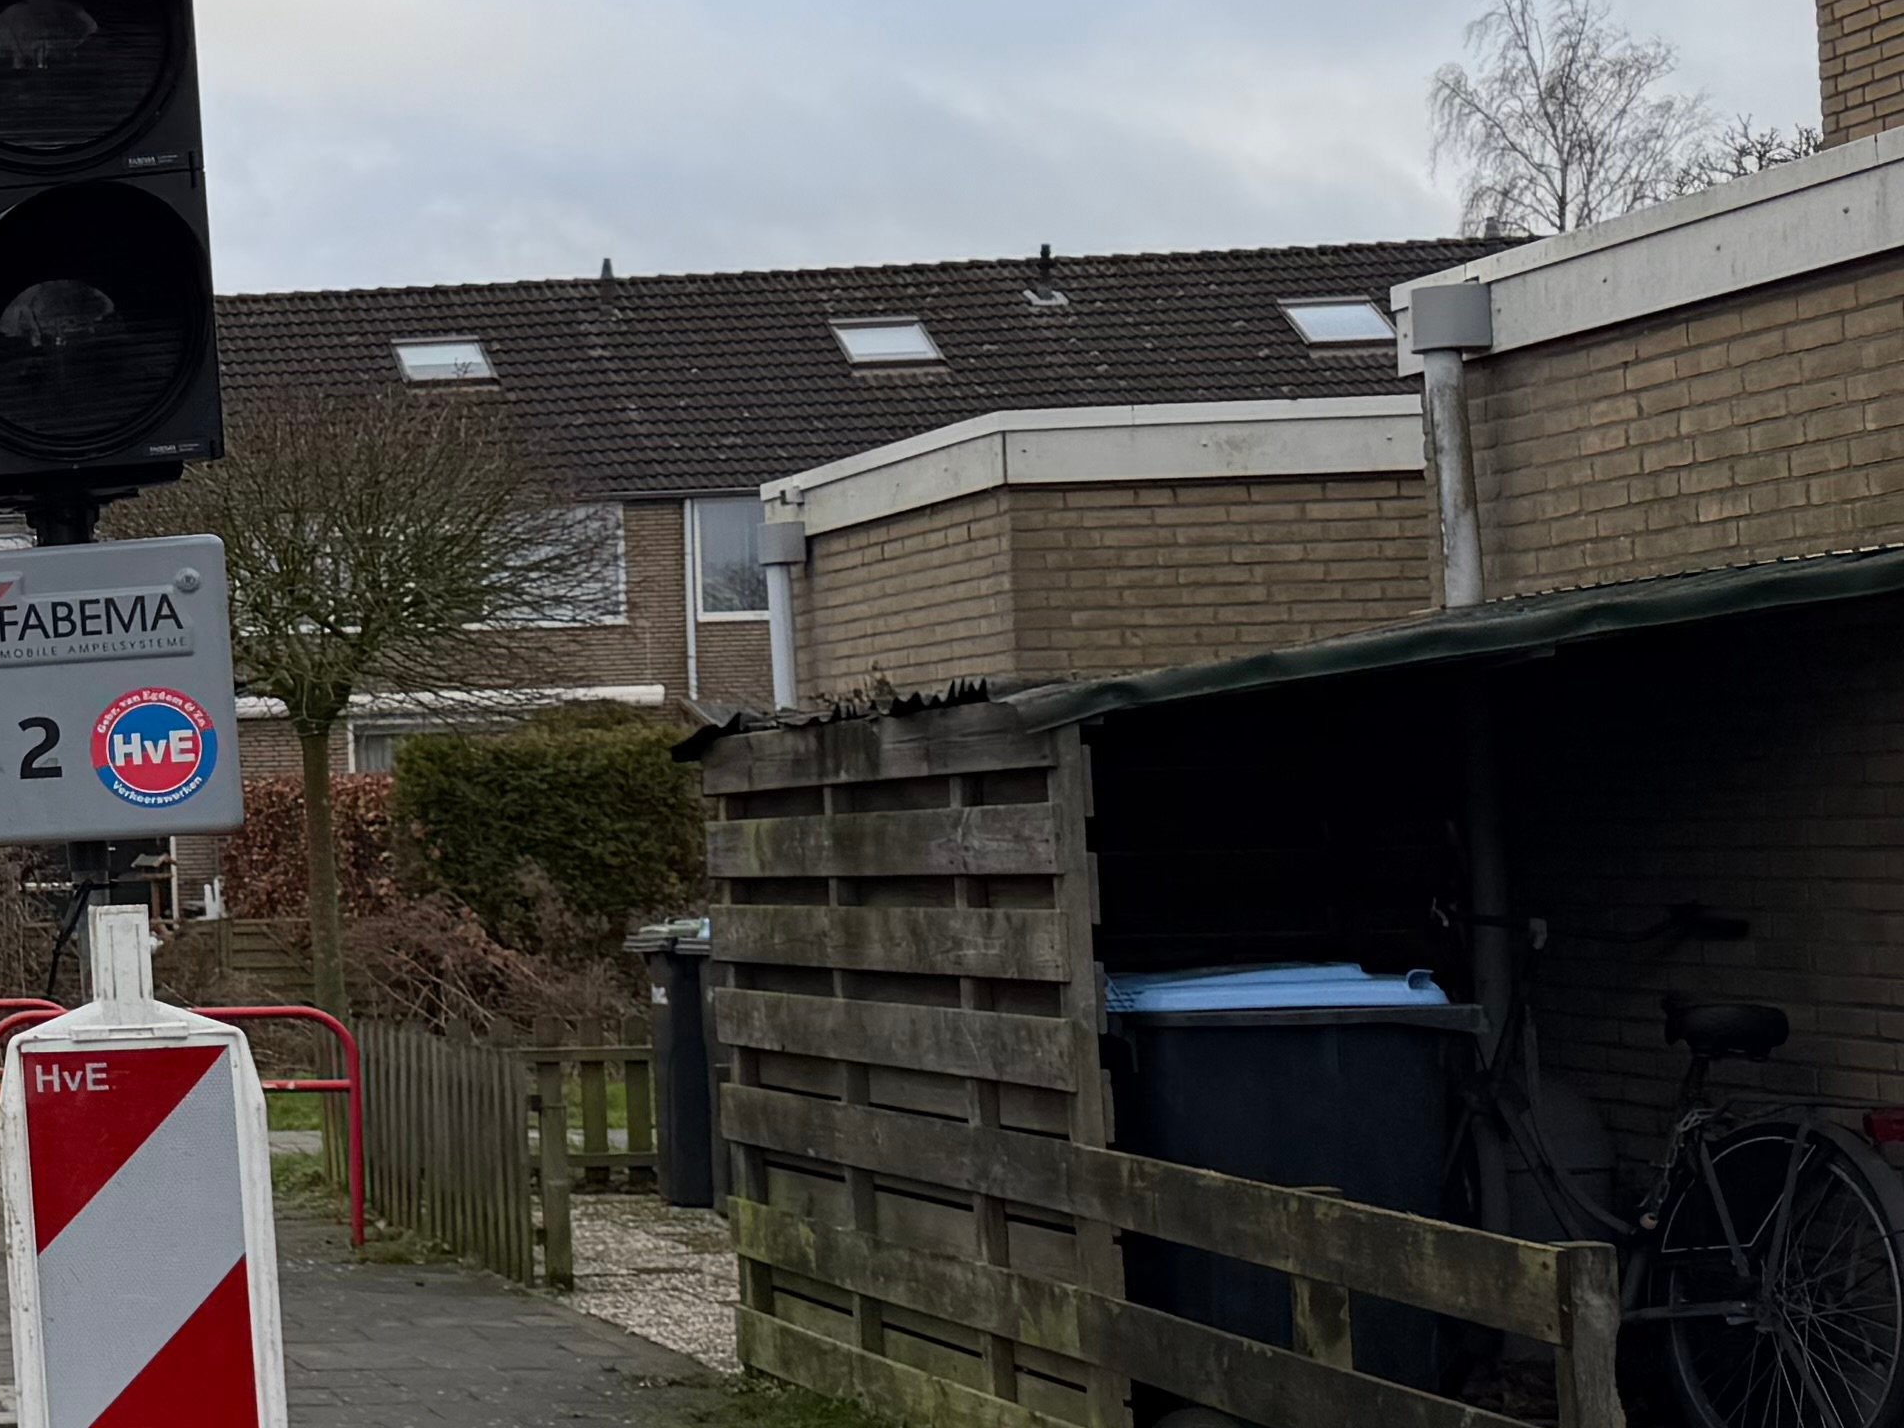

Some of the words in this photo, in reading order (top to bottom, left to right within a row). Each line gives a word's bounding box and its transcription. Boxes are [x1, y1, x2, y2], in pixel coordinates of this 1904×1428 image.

[0, 645, 58, 659] MOBILE
[67, 636, 188, 655] AMPELSYSTEME
[18, 716, 63, 780] 2
[113, 729, 196, 767] HvE
[35, 1061, 110, 1094] HvE
